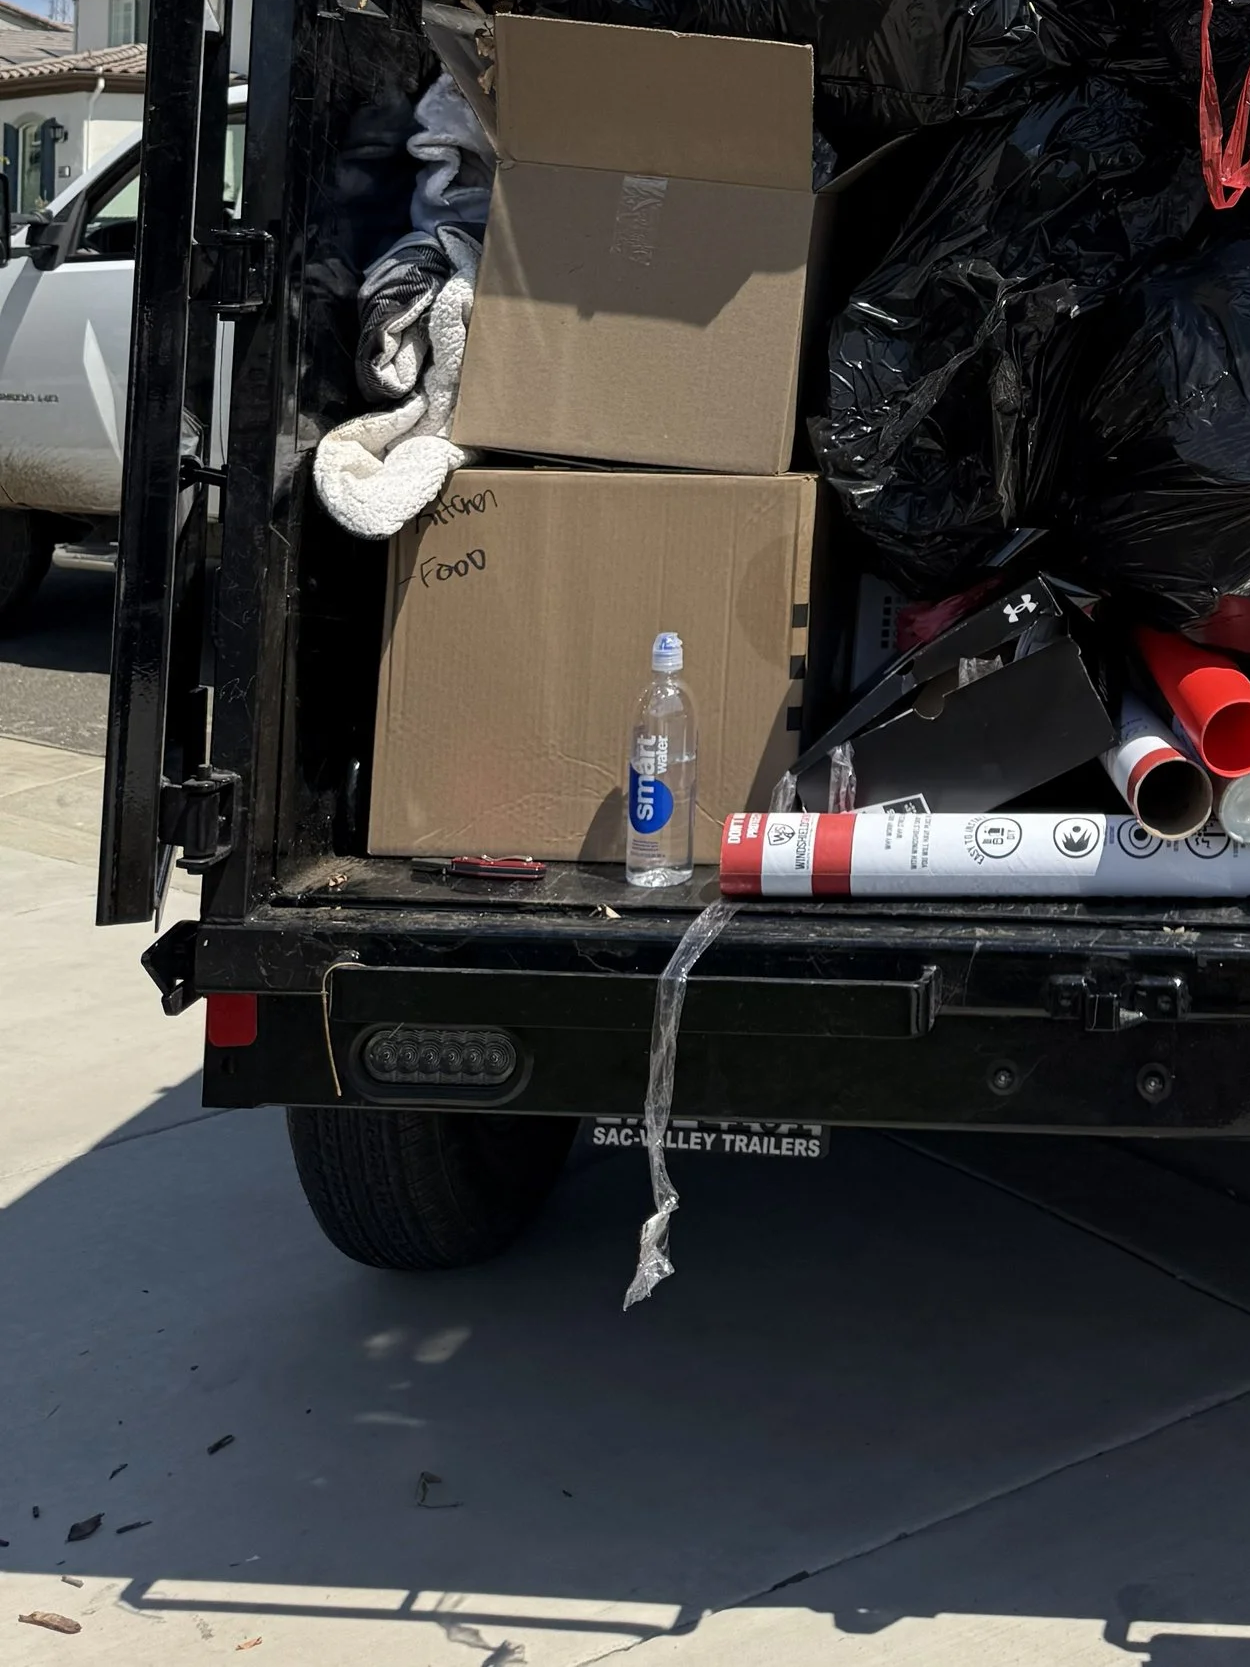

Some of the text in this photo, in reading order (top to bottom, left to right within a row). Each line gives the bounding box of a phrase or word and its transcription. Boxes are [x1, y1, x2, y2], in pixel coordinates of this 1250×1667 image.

[656, 735, 669, 775] water
[636, 734, 658, 822] smart
[966, 845, 985, 865] EASY
[593, 1127, 821, 1158] SAC-VLLEY TRAILERS
